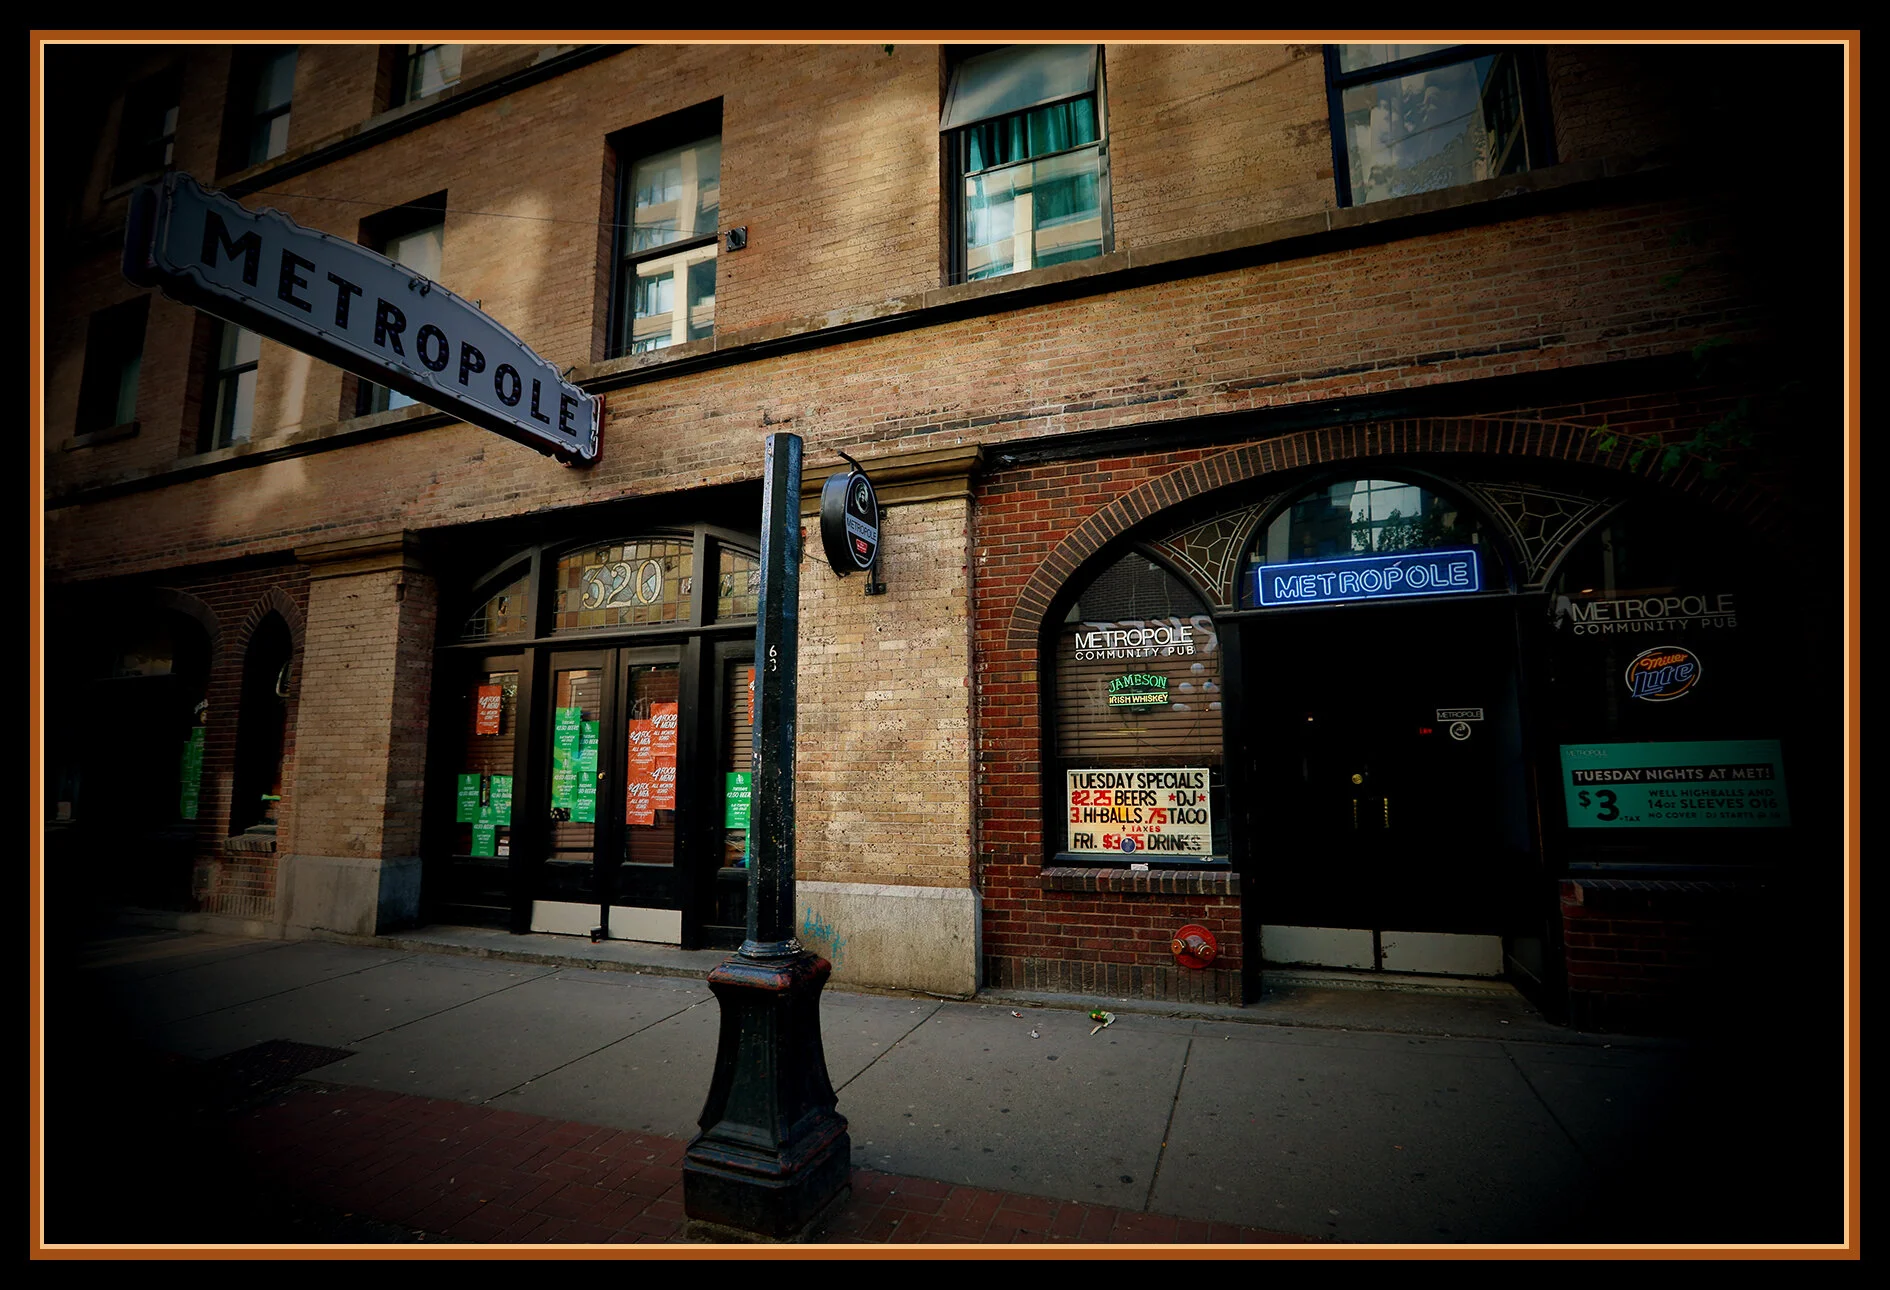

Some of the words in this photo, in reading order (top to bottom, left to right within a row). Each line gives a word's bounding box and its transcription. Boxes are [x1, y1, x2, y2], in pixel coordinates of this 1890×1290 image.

[201, 209, 578, 437] METROPOLE
[847, 517, 877, 541] METROPOLE
[582, 559, 662, 609] 320
[1275, 562, 1469, 598] METROPOLE
[1570, 594, 1736, 621] METROPOLE
[1573, 619, 1689, 635] COMMUNITY
[1701, 616, 1739, 628] PUB
[1075, 626, 1193, 649] METROPOLE
[1075, 648, 1159, 661] COMMUNITY
[1168, 646, 1194, 656] PUB
[1640, 653, 1689, 671] Miller
[1108, 673, 1169, 693] JAMESON
[1631, 662, 1694, 698] Lite
[1109, 695, 1131, 704] IRISH
[1132, 694, 1168, 704] WHISKEY
[652, 714, 663, 728] $4
[1438, 711, 1482, 719] METROPOLE
[1070, 773, 1136, 789] TUESDAY
[1137, 773, 1204, 789] SPECIALS
[1575, 770, 1643, 783] TUESDAY
[1645, 769, 1704, 781] NIGHTS
[1708, 768, 1727, 780] AT
[1731, 767, 1773, 780] MET!
[1071, 790, 1111, 806] $2.25
[1114, 790, 1157, 806] BEERS
[1648, 789, 1678, 798] WELL
[1681, 789, 1744, 797] HIGHBALLS
[1748, 788, 1774, 797] AND
[1680, 799, 1744, 809] SLEEVES
[1144, 807, 1167, 824] .75
[1168, 808, 1207, 824] TACO
[1074, 833, 1097, 849] FRI.
